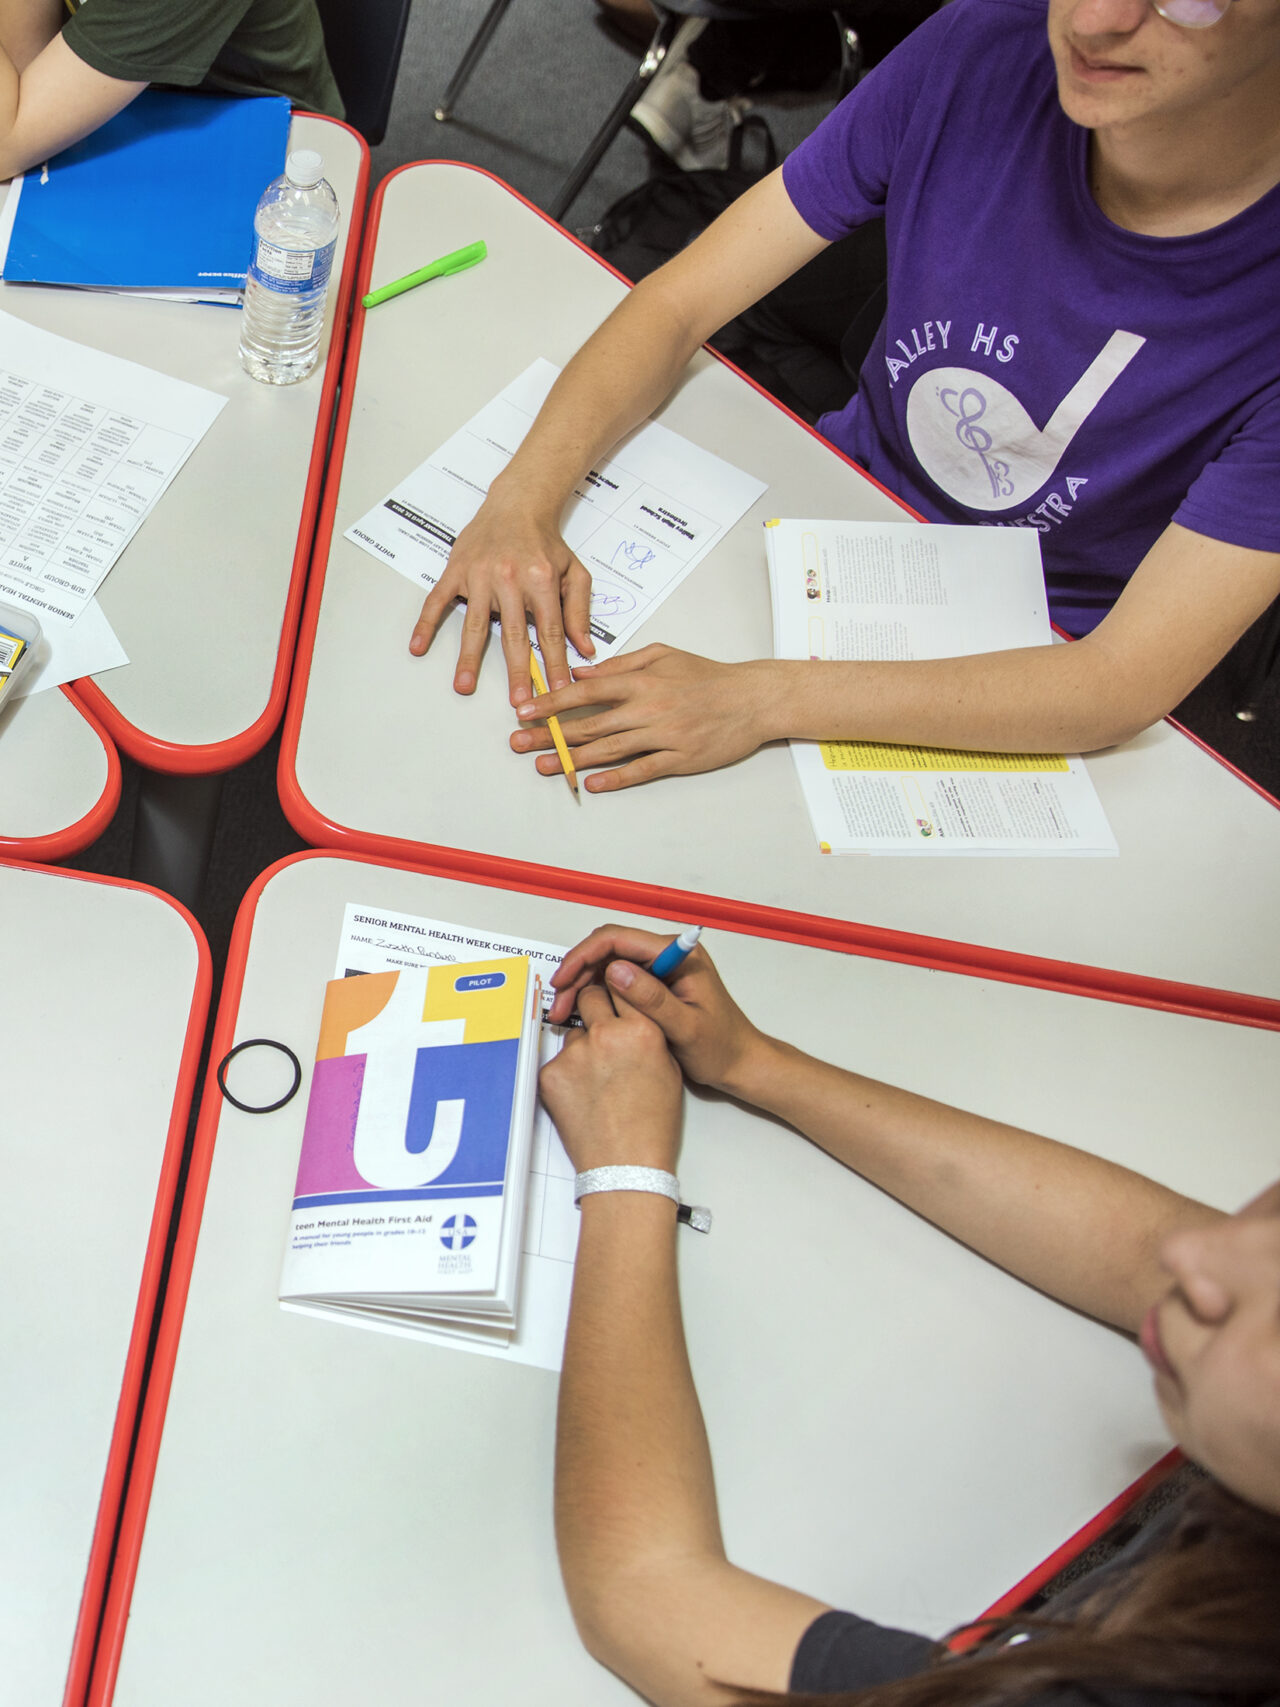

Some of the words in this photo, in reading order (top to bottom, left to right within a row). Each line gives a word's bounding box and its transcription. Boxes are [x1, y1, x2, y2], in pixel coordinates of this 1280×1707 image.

[259, 239, 282, 254] Nutrition
[887, 321, 952, 388] ALLEY
[970, 322, 1020, 363] HS
[639, 501, 663, 522] School
[660, 514, 677, 530] High
[423, 519, 453, 545] THURSDAY
[673, 522, 696, 542] Valley
[373, 541, 395, 560] WHITE
[7, 559, 33, 572] WHITE
[42, 573, 87, 594] SUB-GROUP
[420, 571, 437, 586] ARD
[23, 581, 45, 593] CIRCLE
[15, 591, 48, 608] MENTAL
[46, 604, 75, 619] SENIOR
[350, 934, 372, 944] NAME
[352, 913, 389, 928] SENIOR
[388, 920, 427, 936] MENTAL
[427, 928, 464, 944] HEALTH
[464, 936, 491, 950] WEEK
[491, 941, 523, 957] CHECK
[523, 948, 544, 961] OUT
[385, 957, 403, 966] MAKE
[403, 960, 419, 969] SURE
[468, 977, 492, 987] PILOT
[295, 1222, 315, 1231] teen
[317, 1219, 349, 1228] Mental
[352, 1217, 385, 1226] Health
[389, 1216, 411, 1225] First
[415, 1215, 432, 1224] Aid
[333, 1232, 351, 1240] young
[448, 1228, 468, 1237] USA
